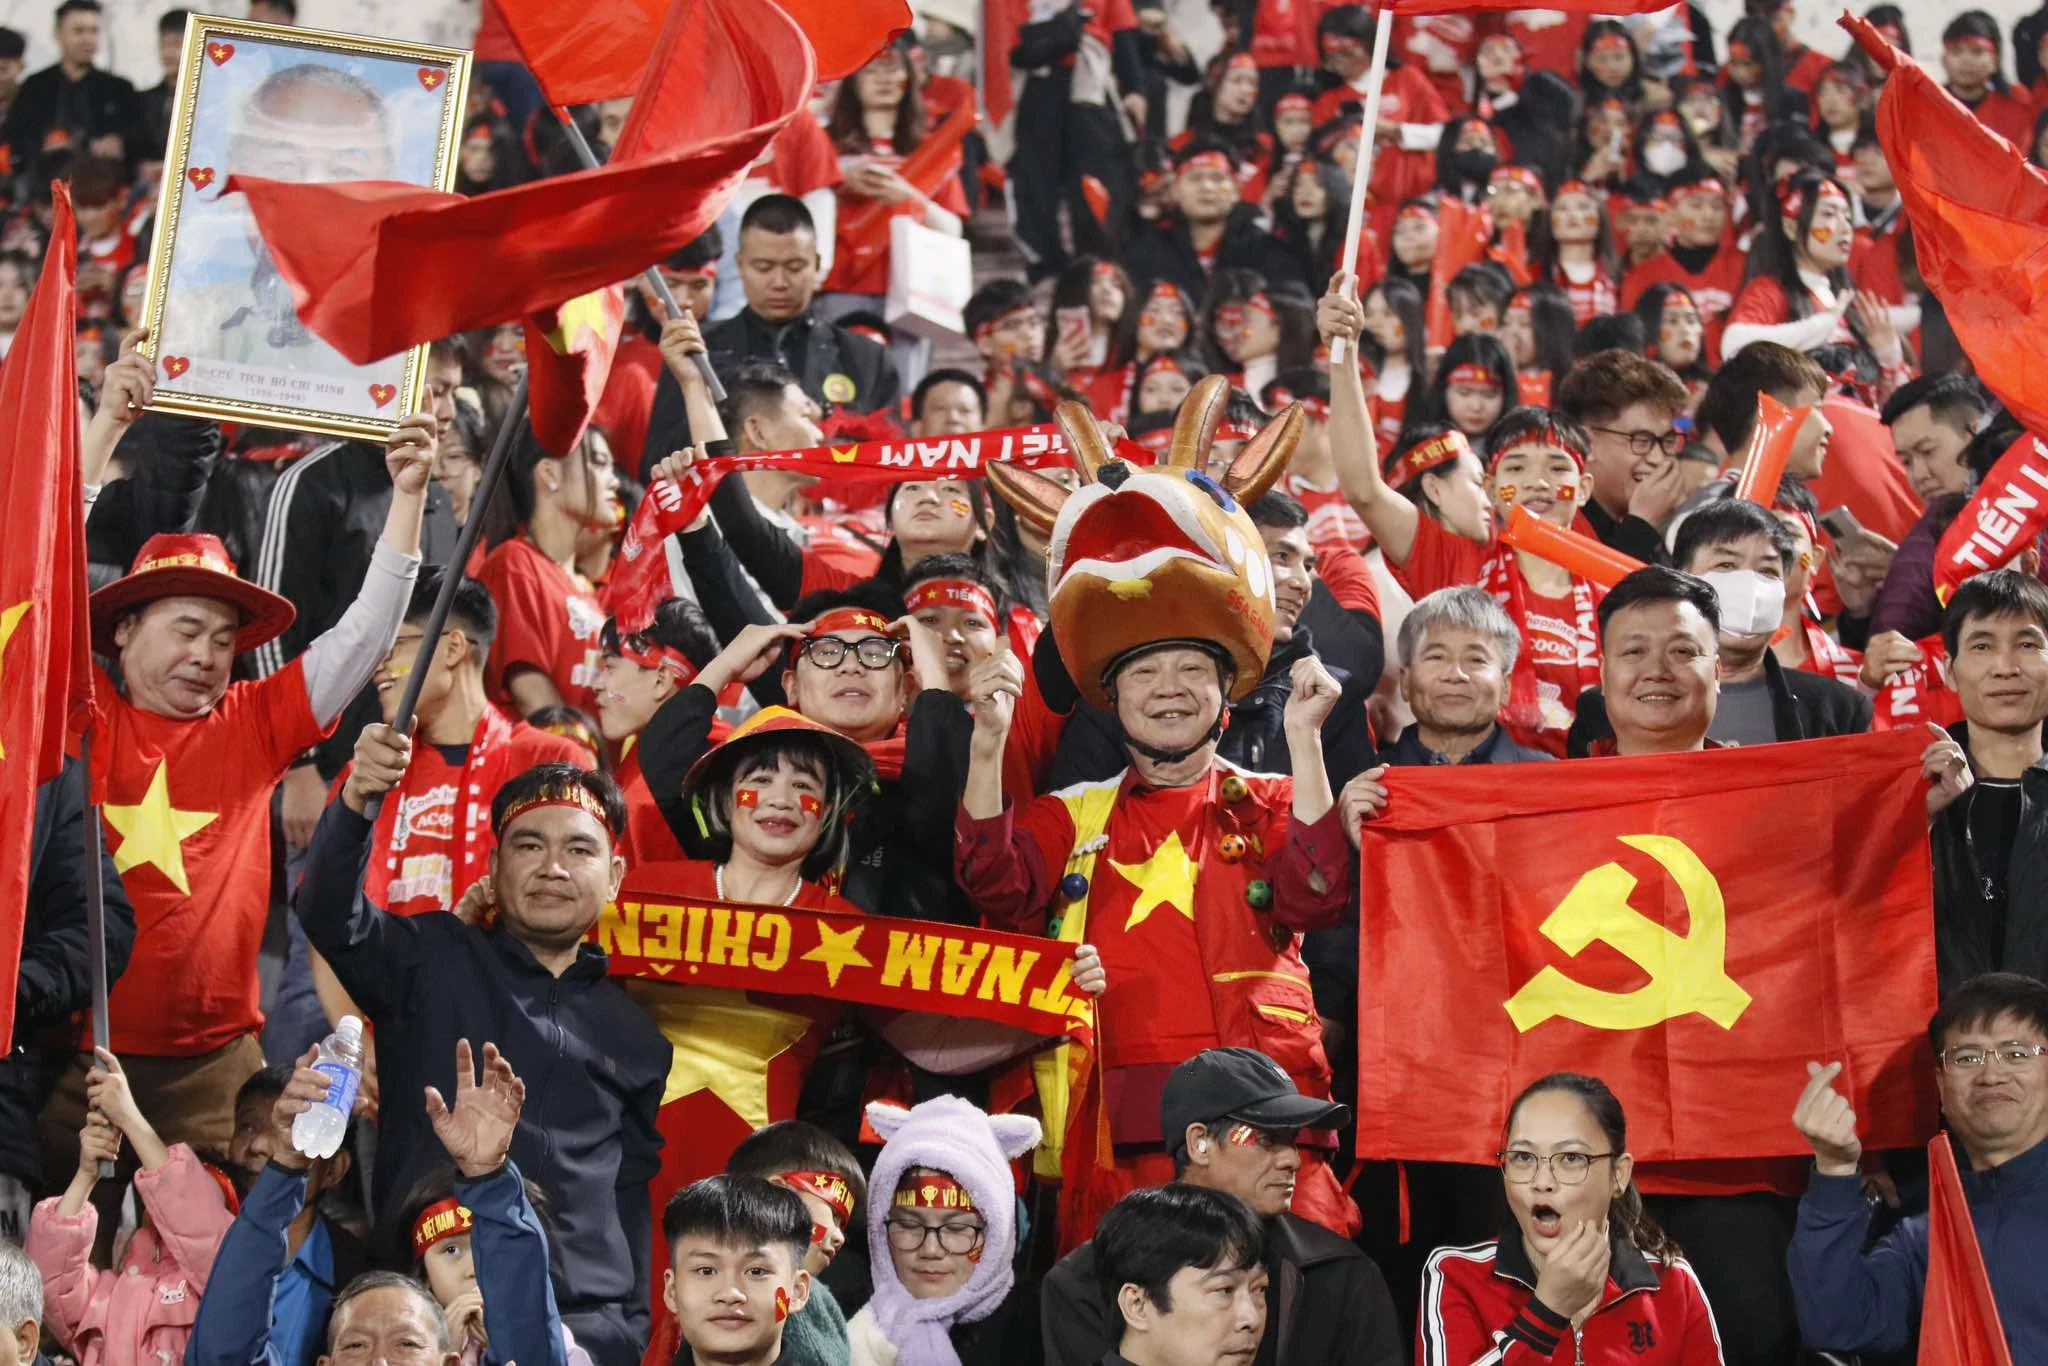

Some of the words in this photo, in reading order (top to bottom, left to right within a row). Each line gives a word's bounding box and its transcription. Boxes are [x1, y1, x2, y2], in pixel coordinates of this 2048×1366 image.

[876, 438, 981, 469] NAM
[995, 426, 1069, 466] IỆT
[1952, 482, 2040, 571] TIẾN
[1530, 638, 1573, 659] OOK
[601, 901, 793, 978] CHIẾN
[880, 929, 1042, 1006] NAM
[421, 1216, 437, 1243] VIỆT
[434, 1209, 456, 1234] NAM
